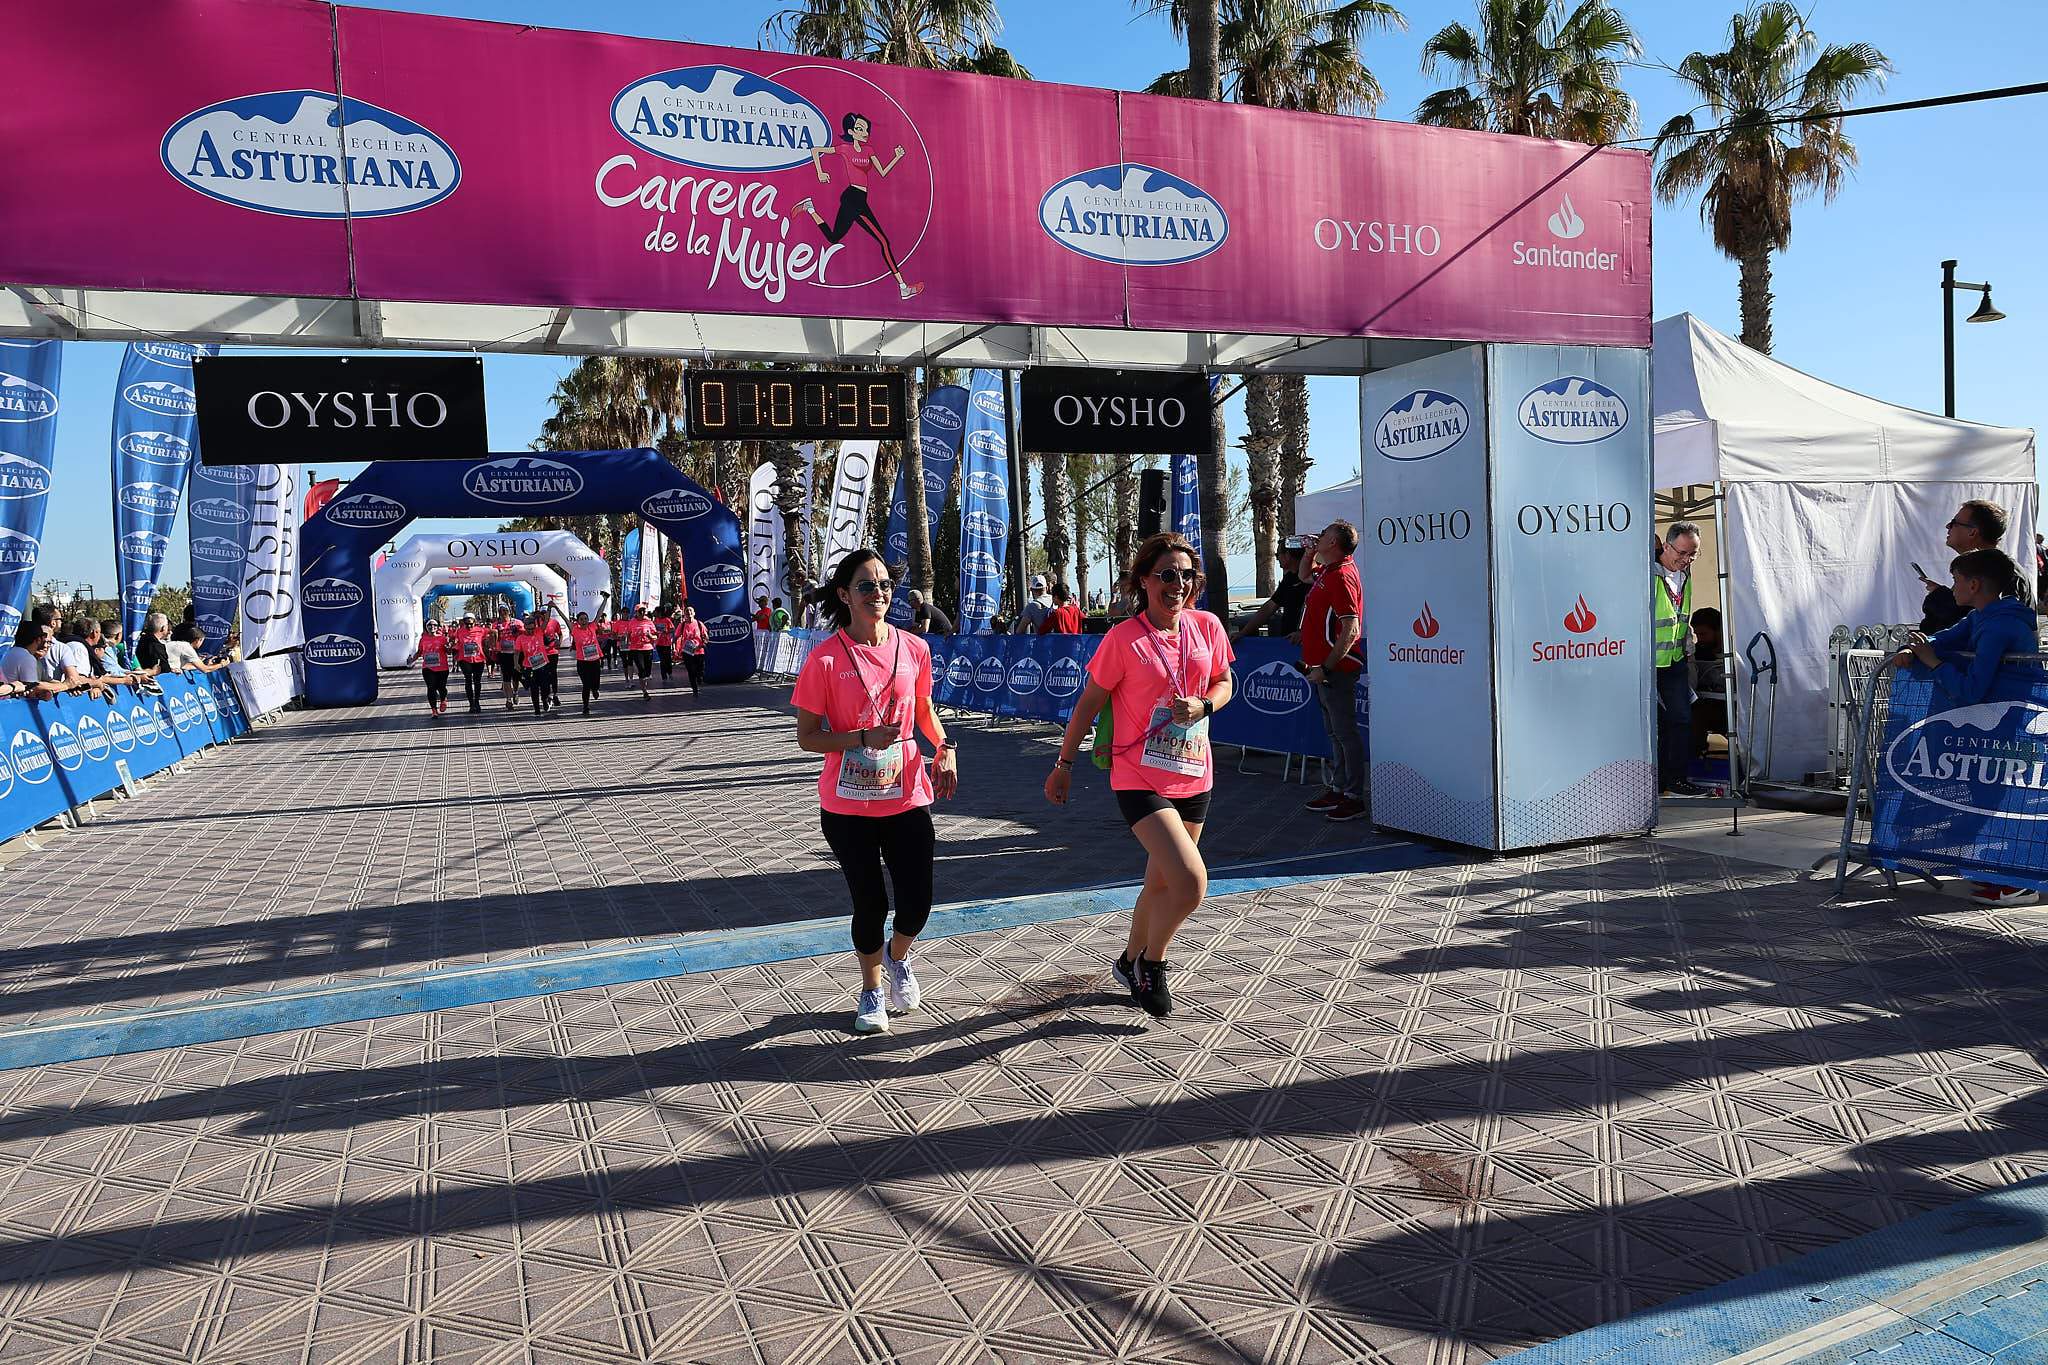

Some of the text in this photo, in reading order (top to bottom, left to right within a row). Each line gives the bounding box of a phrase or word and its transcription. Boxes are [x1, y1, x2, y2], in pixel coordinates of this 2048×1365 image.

[662, 95, 809, 119] CENTRAL LECHERA
[629, 95, 816, 149] ASTURIANA
[232, 129, 327, 149] CENTRAL
[187, 130, 441, 191] ASTURIANA
[595, 154, 778, 219] Carrera
[1083, 196, 1209, 214] CENTRAL LECHERA
[1055, 195, 1216, 242] ASTURIANA
[1314, 217, 1442, 257] OYSHO
[644, 216, 846, 303] de la Mujer
[1512, 241, 1619, 271] Santander
[247, 391, 448, 429] OYSHO
[1053, 395, 1187, 428] OYSHO
[1526, 401, 1621, 428] ASTURIANA
[1542, 400, 1617, 408] CENTRAL LECHERA
[1393, 407, 1459, 426] CENTRAL LECHERA
[1380, 417, 1462, 449] ASTURIANA
[472, 471, 576, 494] ASTURIANA
[331, 508, 400, 520] ASTURIANA
[648, 501, 709, 514] ASTURIANA
[1517, 502, 1631, 535] OYSHO
[1378, 509, 1471, 545] OYSHO
[447, 538, 540, 558] OYSHO
[391, 561, 420, 569] OYSHO
[304, 590, 360, 602] ASTURIANA
[380, 597, 409, 605] OYSHO
[708, 625, 749, 638] STURIANA
[307, 646, 362, 658] ASTURIANA
[1388, 643, 1465, 665] Santander
[1532, 637, 1626, 662] Santander
[1247, 679, 1304, 703] ASTURIANA
[1943, 736, 2023, 752] CENTRAL
